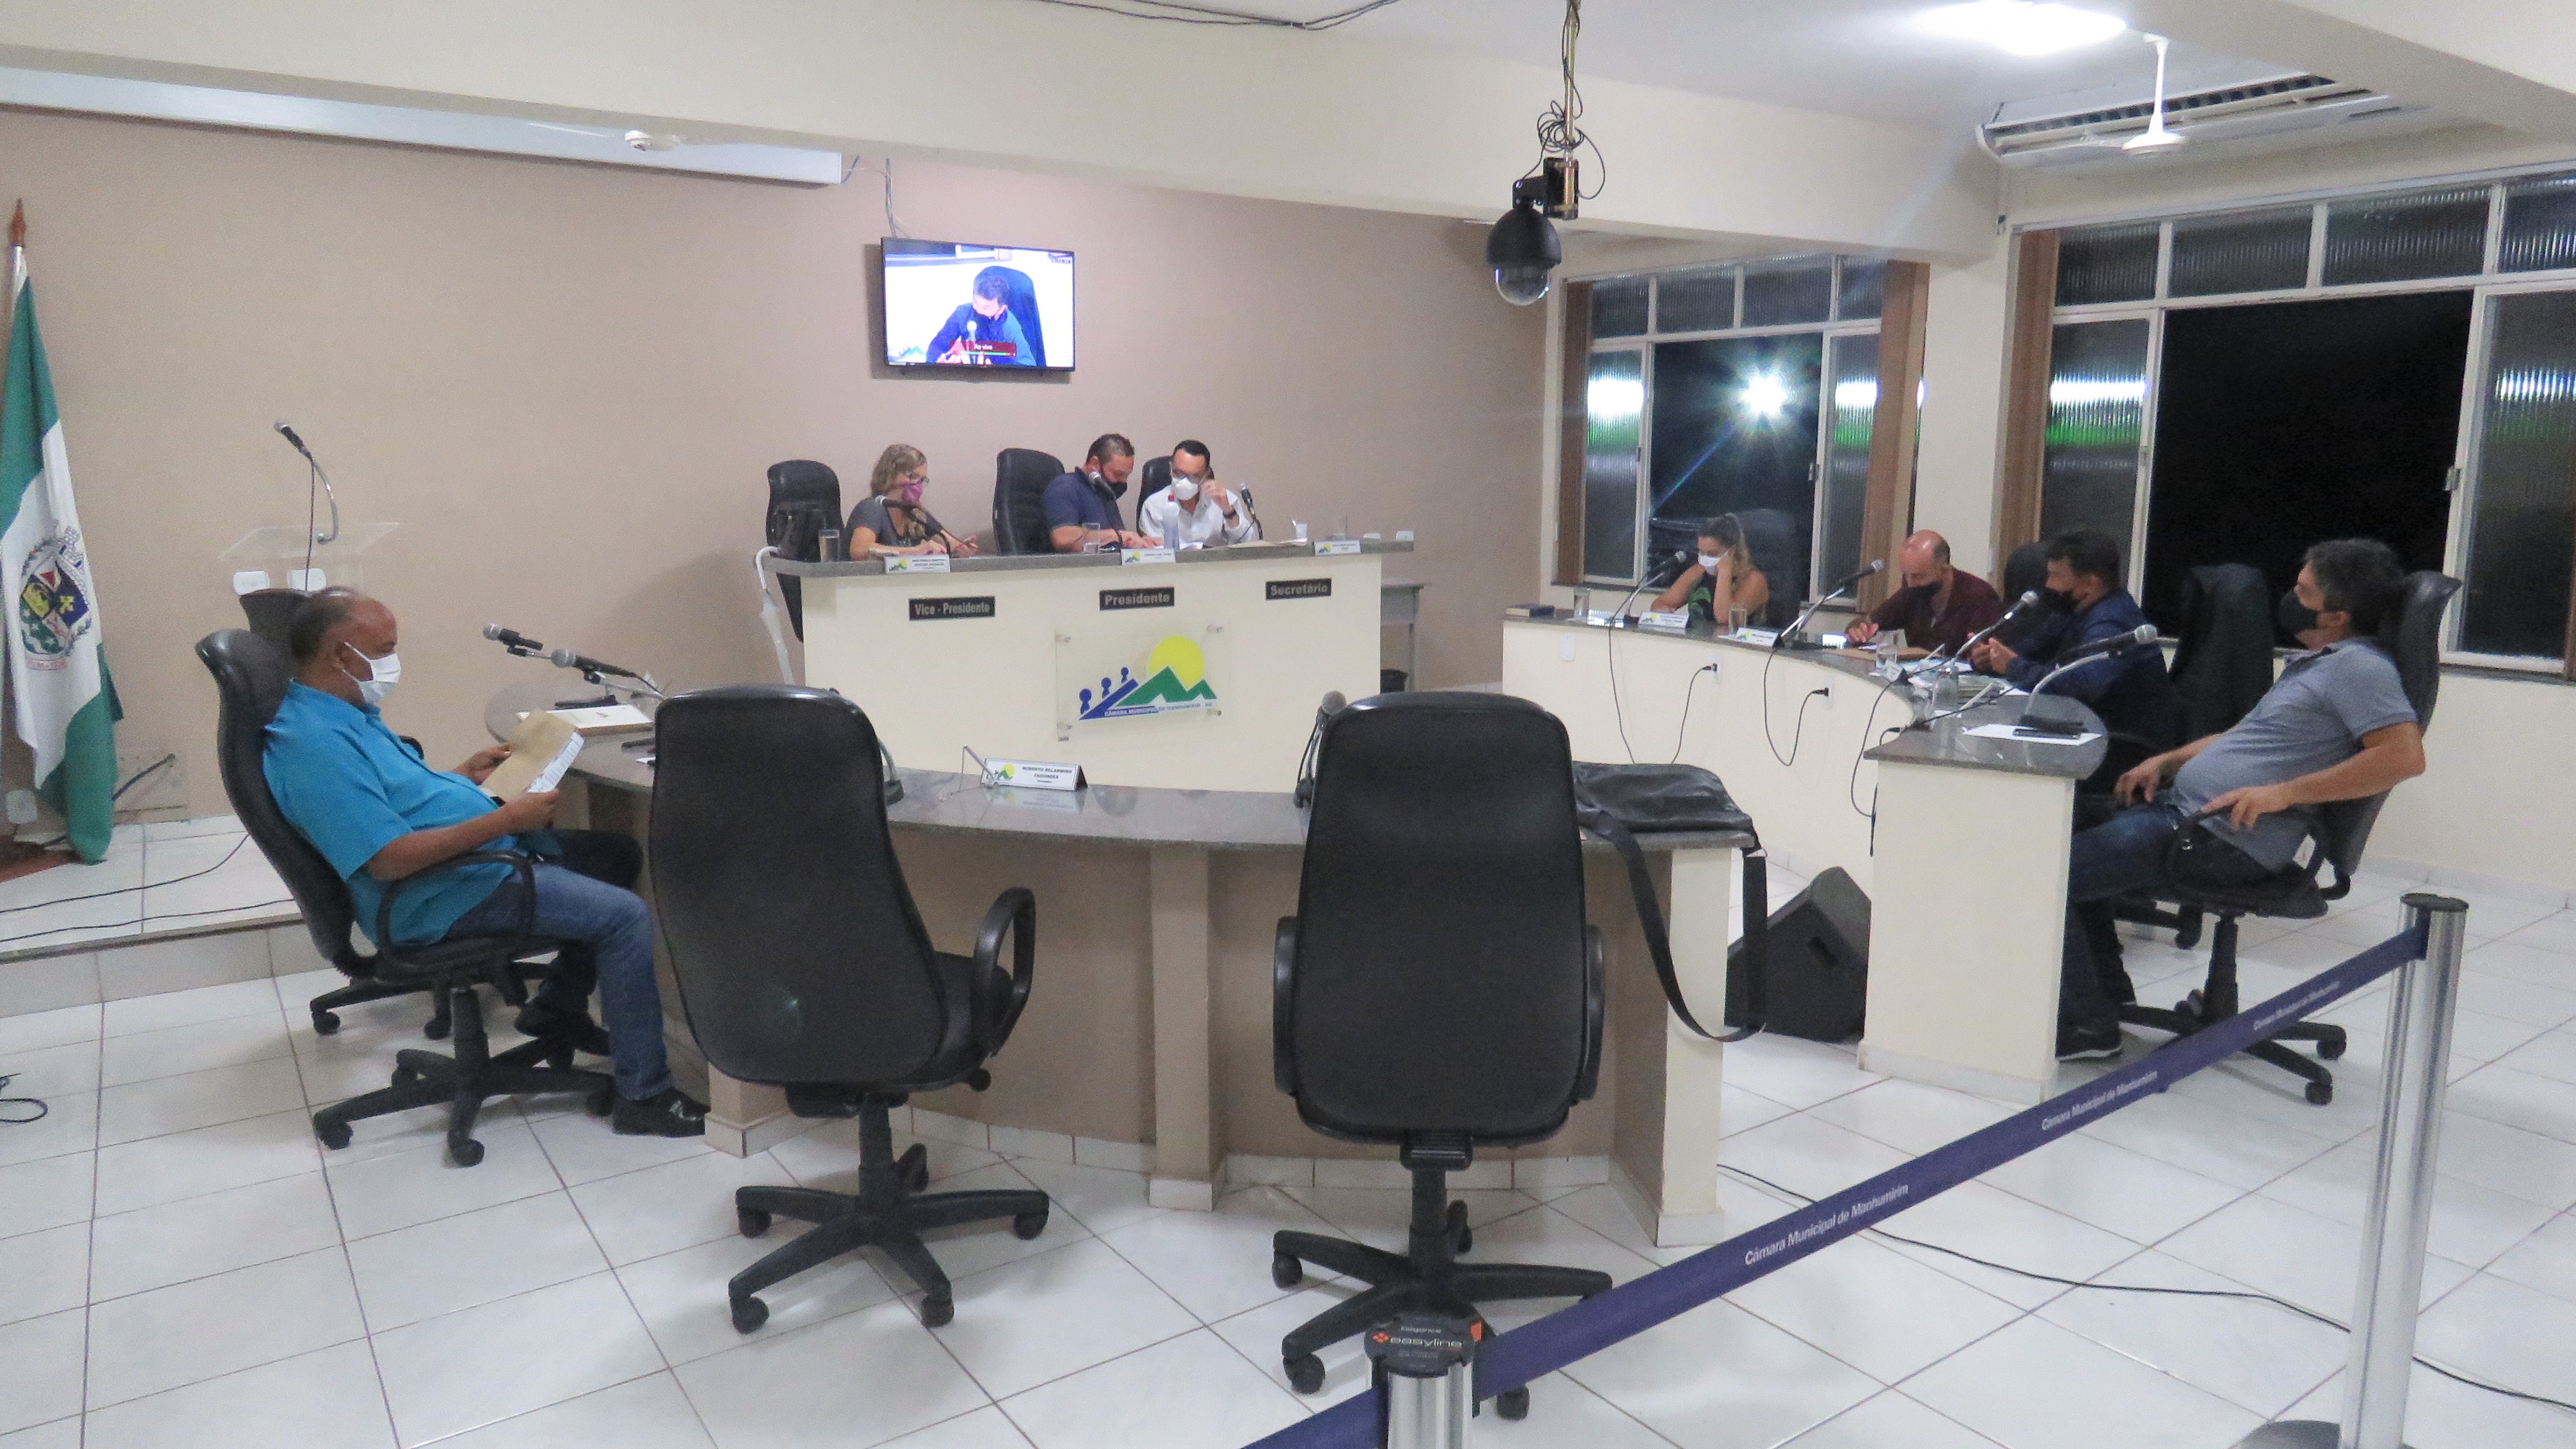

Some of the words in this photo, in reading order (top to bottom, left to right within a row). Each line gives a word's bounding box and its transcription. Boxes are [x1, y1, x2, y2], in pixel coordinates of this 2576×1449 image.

[1270, 583, 1328, 596] Secretário
[1104, 593, 1171, 606] Presidente
[914, 603, 936, 615] Vice
[943, 602, 990, 614] Presidente
[1744, 1238, 1786, 1266] Câmara
[1787, 1214, 1836, 1247] Municipal
[1837, 1209, 1849, 1225] de
[1851, 1183, 1909, 1218] Manhumirim
